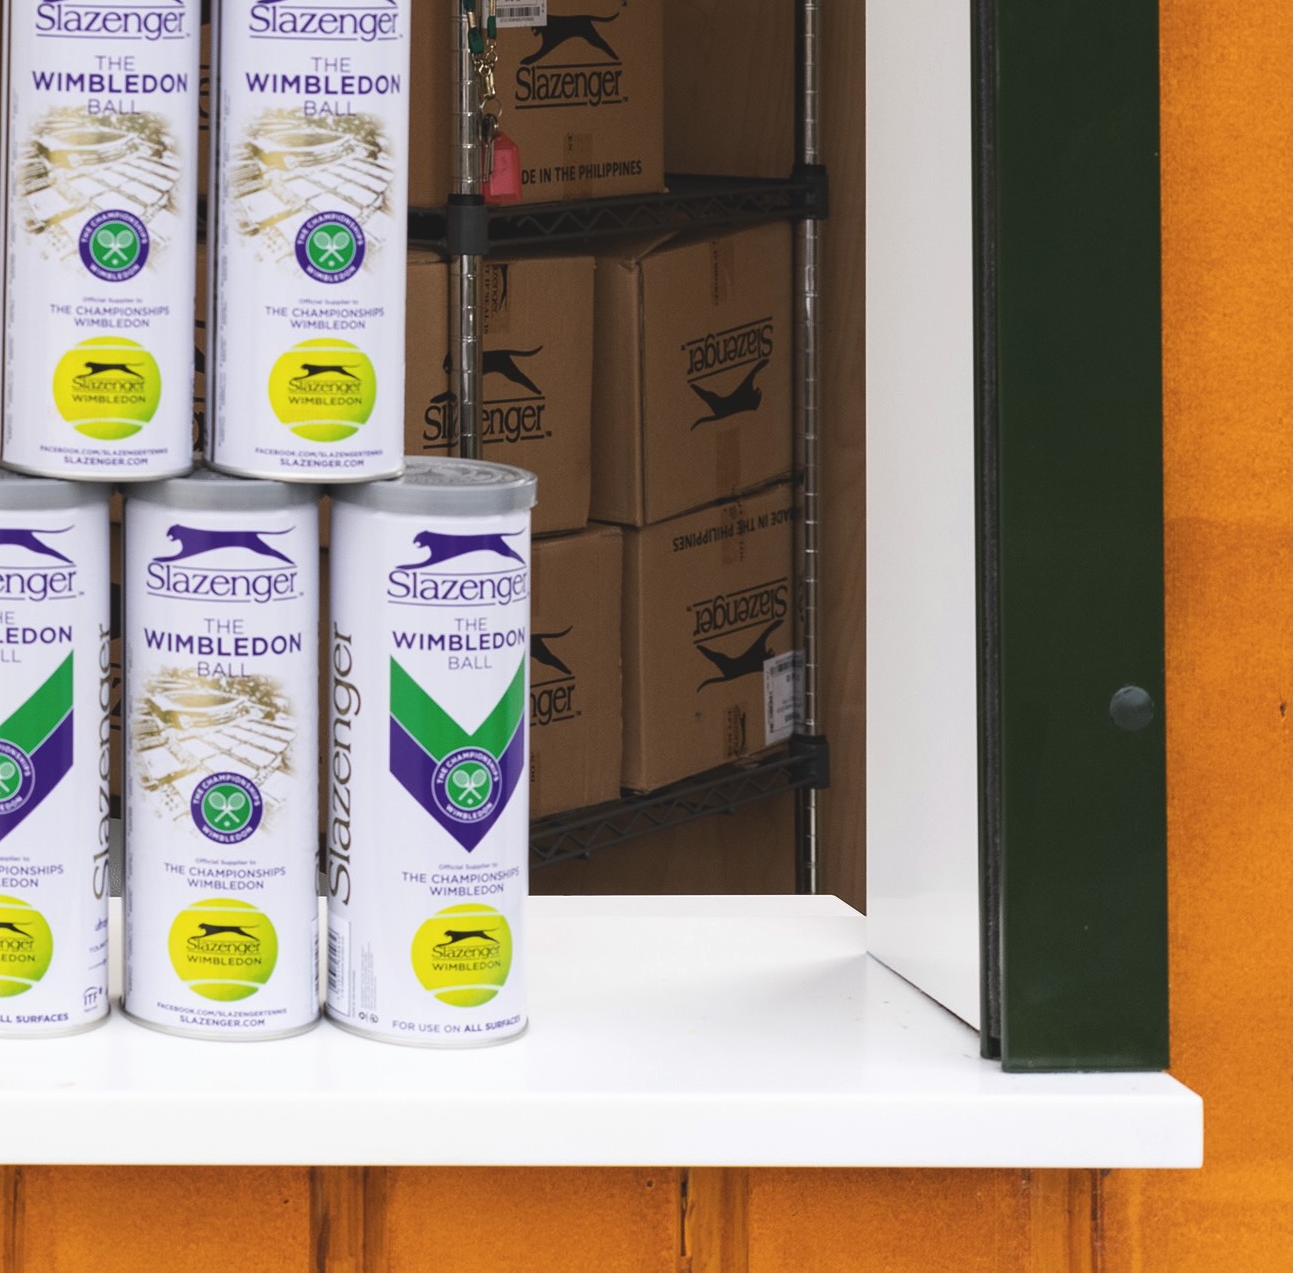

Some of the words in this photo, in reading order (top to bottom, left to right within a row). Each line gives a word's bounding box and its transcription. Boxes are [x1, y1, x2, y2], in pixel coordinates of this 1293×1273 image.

[35, 3, 185, 41] Slazenger
[249, 4, 398, 42] Slazenger
[95, 56, 135, 71] THE
[311, 57, 350, 72] THE
[32, 71, 188, 93] WIMBLEDON
[246, 72, 401, 95] WIMBLEDON
[516, 67, 622, 106] Slazenger
[88, 100, 141, 115] BALL
[303, 100, 356, 117] BALL
[522, 170, 536, 184] DE
[540, 168, 551, 183] IN
[556, 166, 575, 182] THE
[579, 160, 642, 180] PHILIPPINES
[51, 304, 72, 315] THE
[76, 305, 169, 317] CHAMPIONSHIPS
[266, 306, 287, 316] THE
[292, 306, 384, 318] CHAMPIONSHIPS
[74, 318, 149, 328] WIMBLEDON
[290, 319, 365, 329] WIMBLEDON
[687, 325, 773, 375] Slazenger
[72, 395, 146, 404] WIMBLEDON
[289, 396, 362, 406] WIMBLEDON
[423, 405, 545, 443] Slenger
[64, 456, 148, 465] SLAZENGER.COM
[280, 458, 364, 467] SLAZENGER.COM
[737, 518, 755, 535] THE
[758, 515, 769, 528] IN
[673, 526, 734, 552] PHILIPPINES
[146, 562, 297, 603] Slazenger
[387, 571, 527, 605] Slazenger
[694, 586, 788, 636] Slazenger
[204, 618, 244, 635] THE
[454, 618, 487, 632] THE
[144, 628, 302, 656] WIMBLEDON
[392, 628, 525, 650] WIMBLEDON
[198, 662, 250, 678] BALL
[448, 657, 492, 670] BALL
[330, 622, 361, 906] Slazenger
[164, 862, 185, 875] THE
[189, 866, 286, 878] CHAMPIONSHIPS
[402, 872, 426, 883] THE
[432, 868, 519, 884] CHAMPIONSHIPS
[188, 878, 264, 890] WIMBLEDON
[430, 884, 504, 896] WIMBLEDON
[187, 955, 262, 966] WIMBLEDON
[432, 961, 501, 971] WIMBLEDON
[16, 1012, 68, 1023] SURFACES
[180, 1015, 264, 1027] SLAZENGER.COM
